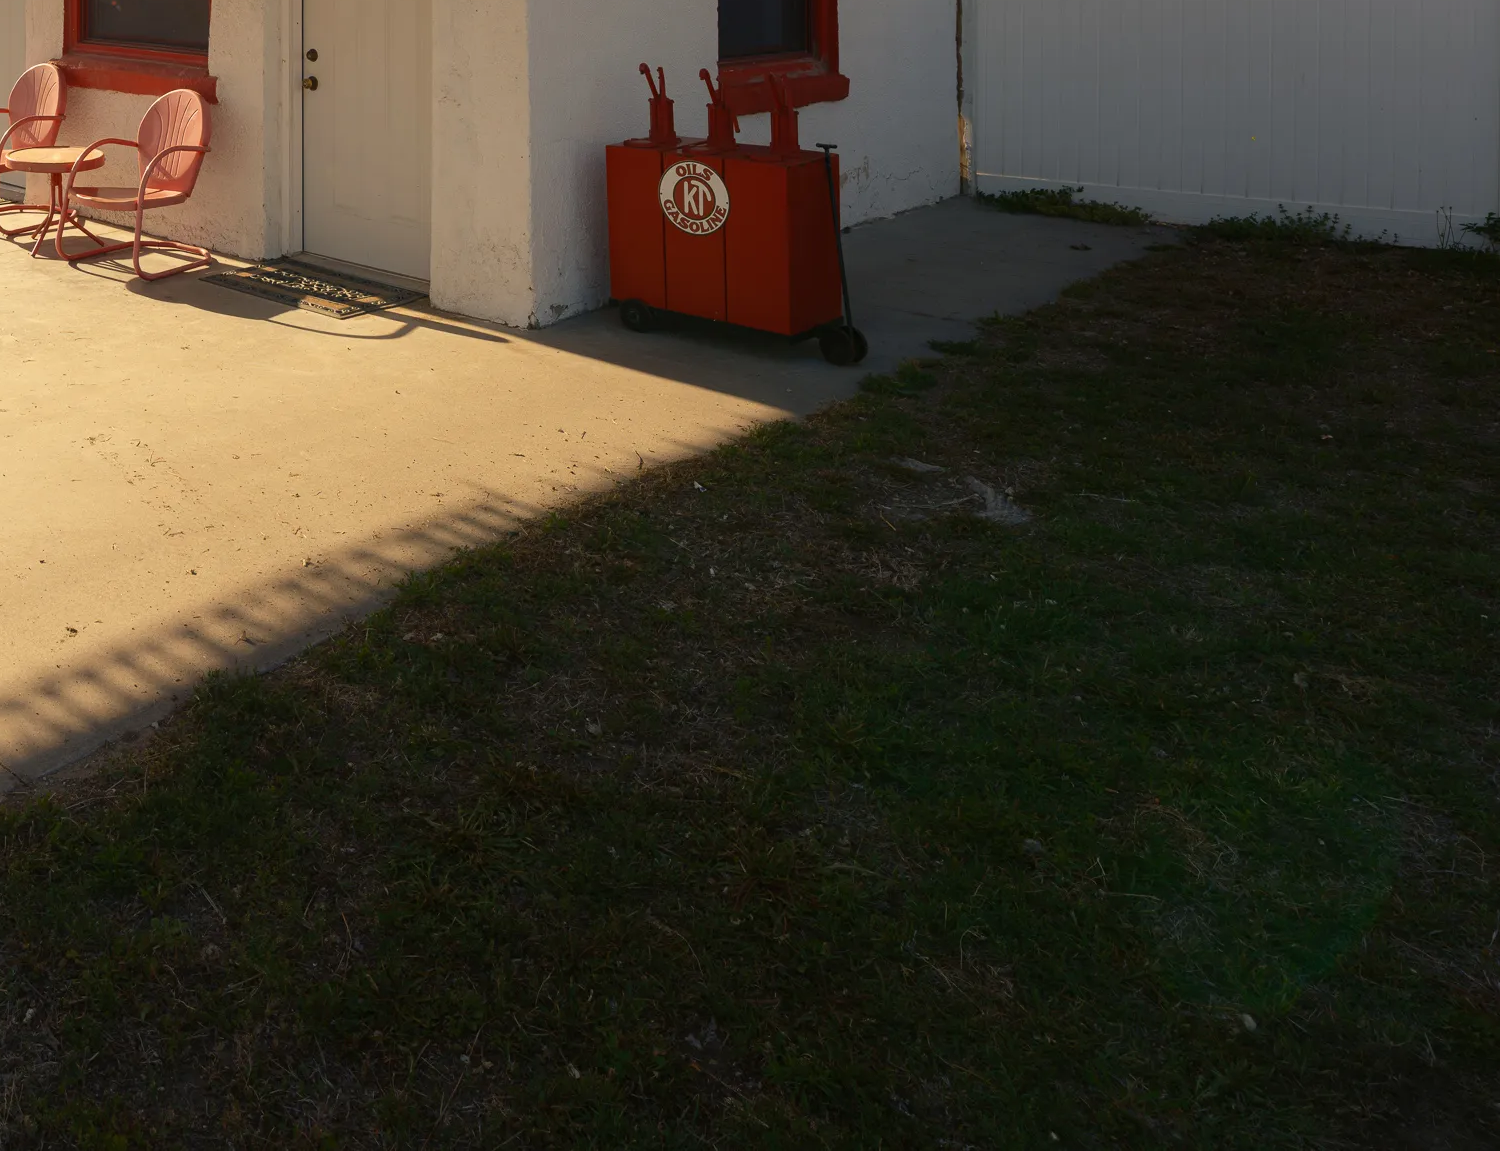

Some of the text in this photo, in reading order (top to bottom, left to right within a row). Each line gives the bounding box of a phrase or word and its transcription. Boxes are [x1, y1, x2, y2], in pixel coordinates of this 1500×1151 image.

[675, 164, 714, 182] OILS
[684, 179, 712, 216] KT
[663, 199, 727, 233] GASOLINE
